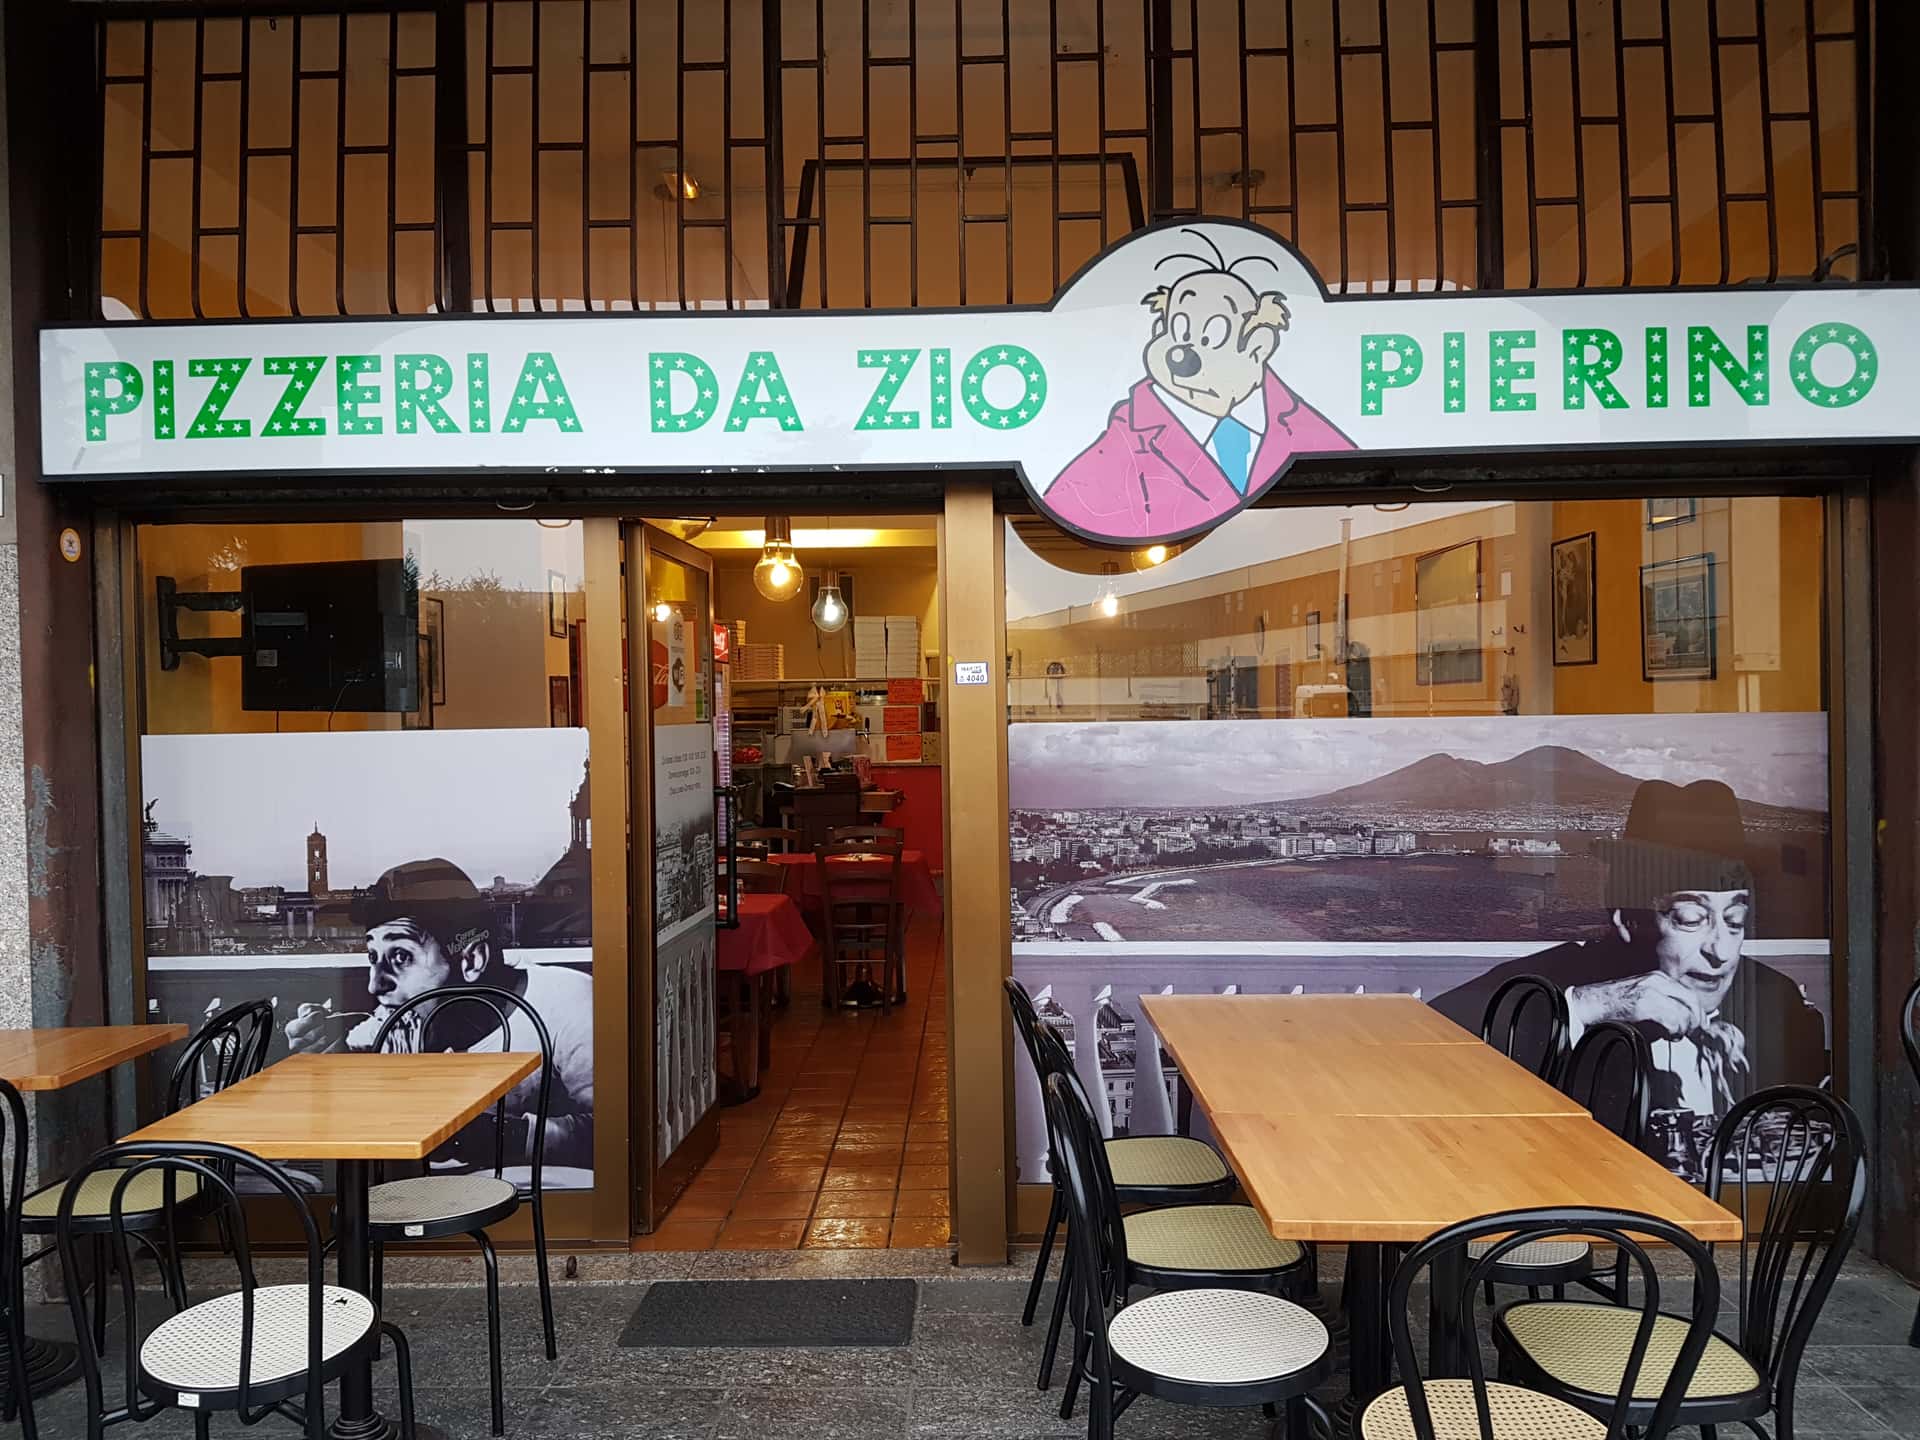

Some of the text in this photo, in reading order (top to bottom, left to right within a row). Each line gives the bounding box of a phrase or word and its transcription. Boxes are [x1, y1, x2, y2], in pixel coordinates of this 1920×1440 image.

[84, 322, 1879, 442] PIZZERIA DA ZIO PIERINO
[966, 674, 985, 682] 4040
